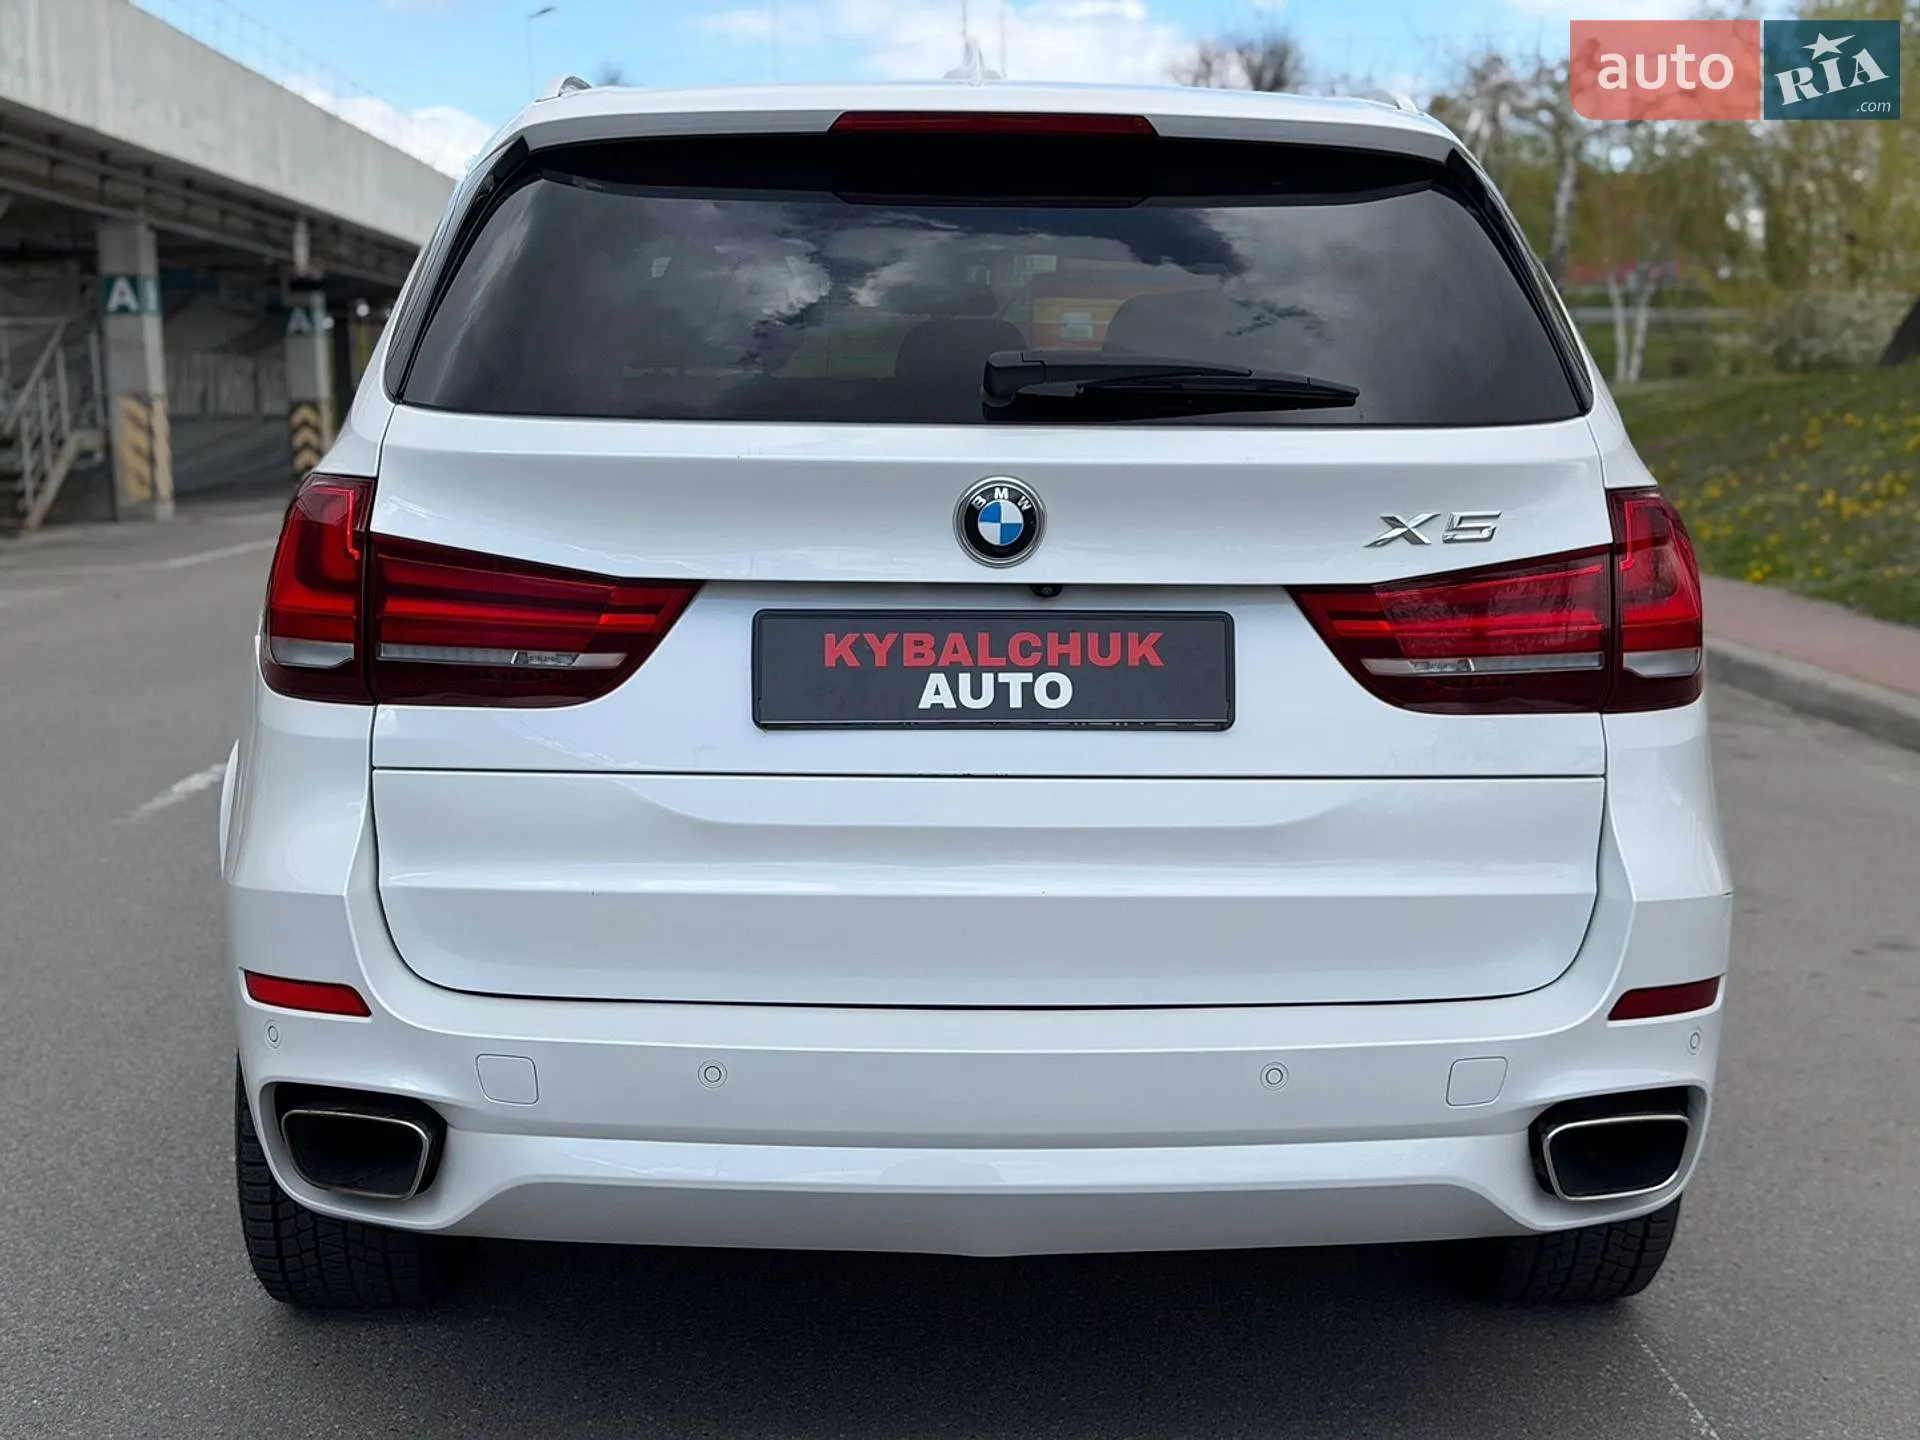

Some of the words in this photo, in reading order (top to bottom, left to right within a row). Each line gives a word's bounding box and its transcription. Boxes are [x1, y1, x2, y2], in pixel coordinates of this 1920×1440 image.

[107, 276, 139, 312] A
[971, 487, 1032, 511] BMW
[1361, 511, 1502, 548] X5
[824, 632, 1164, 667] KYBALCHUK
[918, 672, 1073, 709] AUTO
